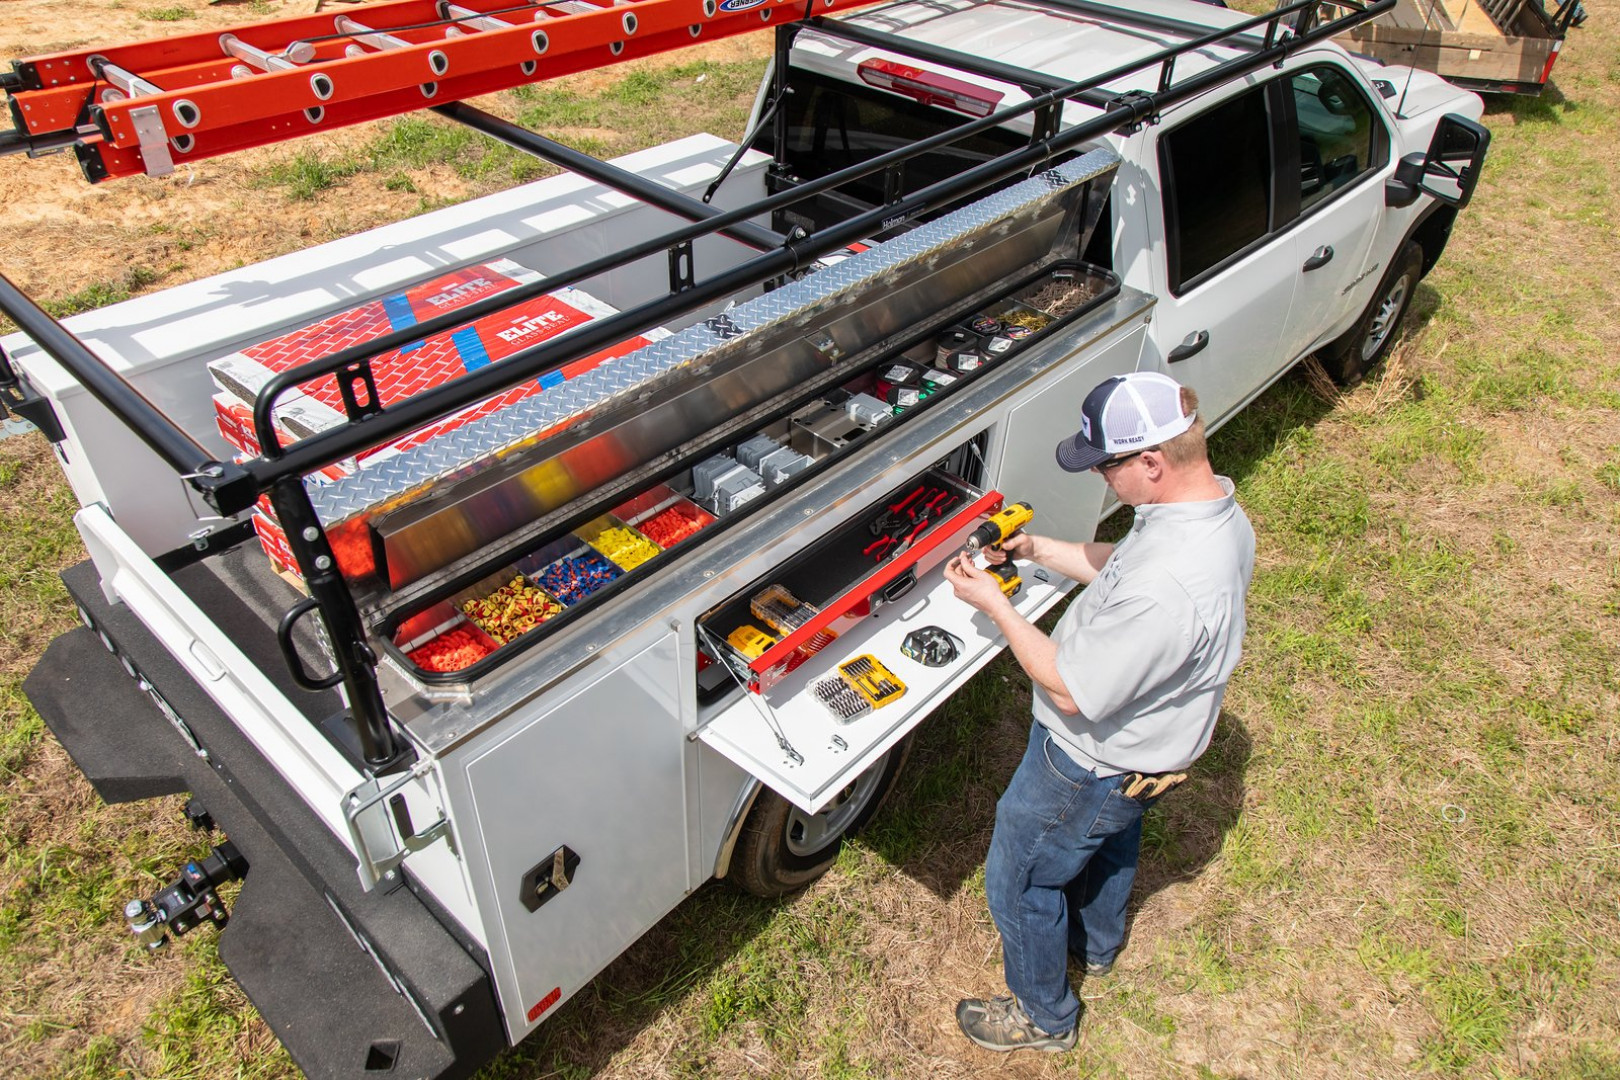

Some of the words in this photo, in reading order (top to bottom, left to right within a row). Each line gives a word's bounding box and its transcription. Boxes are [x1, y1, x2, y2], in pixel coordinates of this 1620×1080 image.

[883, 215, 905, 229] Holman
[425, 277, 492, 305] ELITE
[496, 310, 564, 342] ELITE
